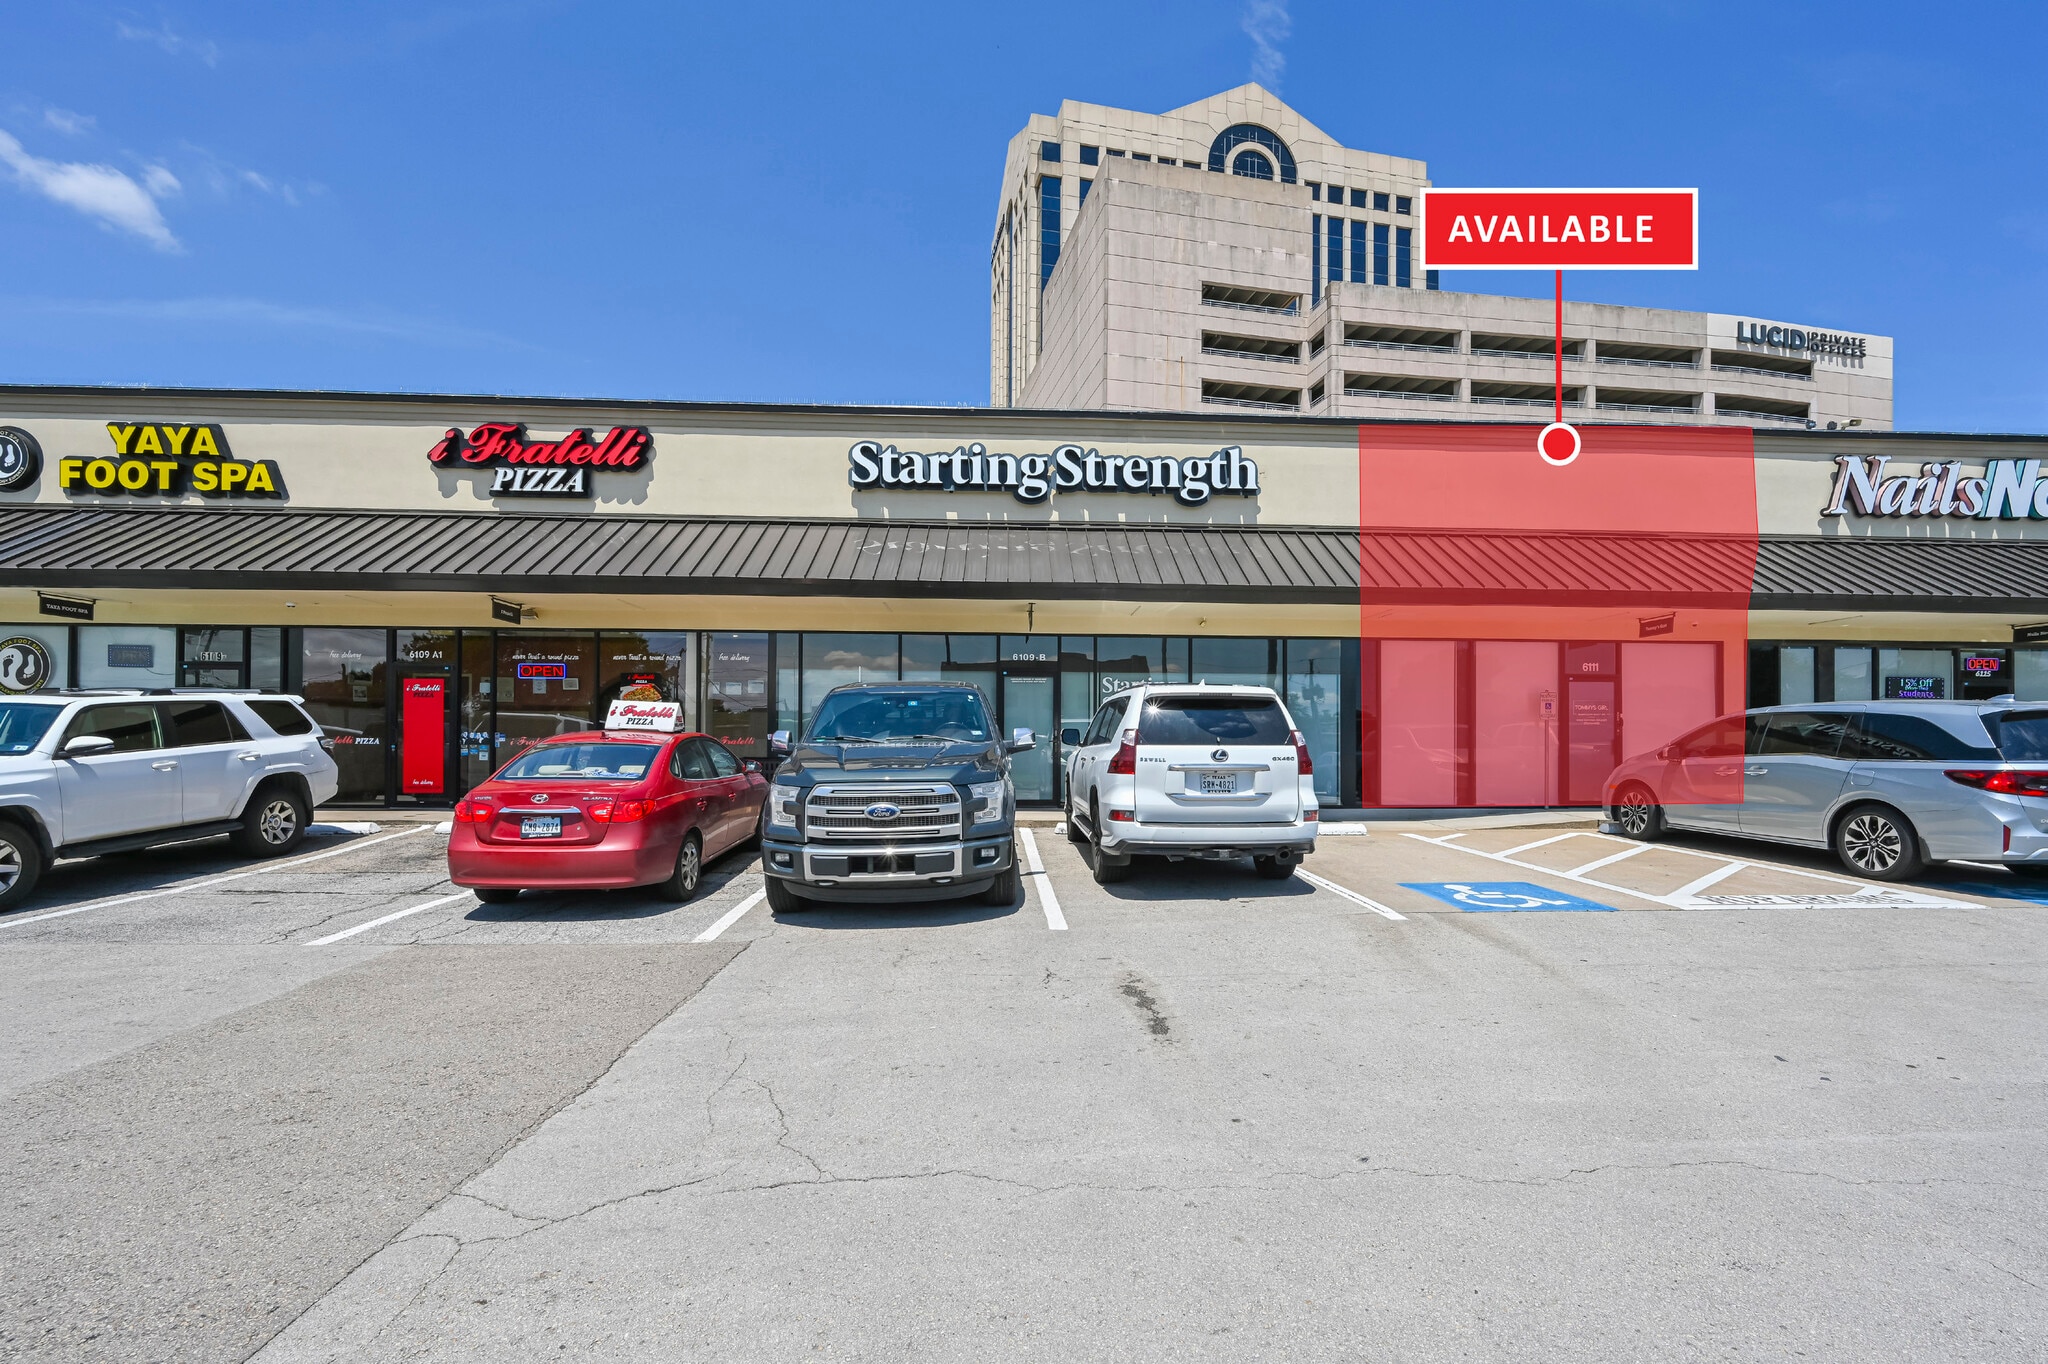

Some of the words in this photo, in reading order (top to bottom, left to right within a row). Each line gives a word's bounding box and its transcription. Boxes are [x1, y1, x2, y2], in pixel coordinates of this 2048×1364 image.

[1737, 321, 1806, 350] LUCID
[1811, 332, 1866, 348] PRIVATE
[1811, 342, 1867, 358] OFFICES
[106, 425, 220, 456] YAYA
[429, 430, 456, 462] i
[461, 422, 647, 466] Fratelli
[59, 459, 178, 490] FOOT
[192, 462, 275, 492] SPA
[851, 442, 1049, 498] Starting
[1053, 446, 1259, 501] Strength
[490, 467, 584, 493] PIZZA
[1822, 455, 1989, 517] Nails
[409, 650, 430, 659] 6109
[432, 650, 443, 659] A1
[521, 665, 564, 677] OPEN
[1582, 662, 1599, 672] 6111
[1968, 659, 1997, 669] OPEN
[412, 683, 441, 692] Fratelli
[1899, 690, 1934, 698] Students
[610, 706, 618, 716] i
[619, 704, 675, 718] Fratelli
[626, 717, 654, 726] PIZZA
[872, 807, 892, 817] Ford
